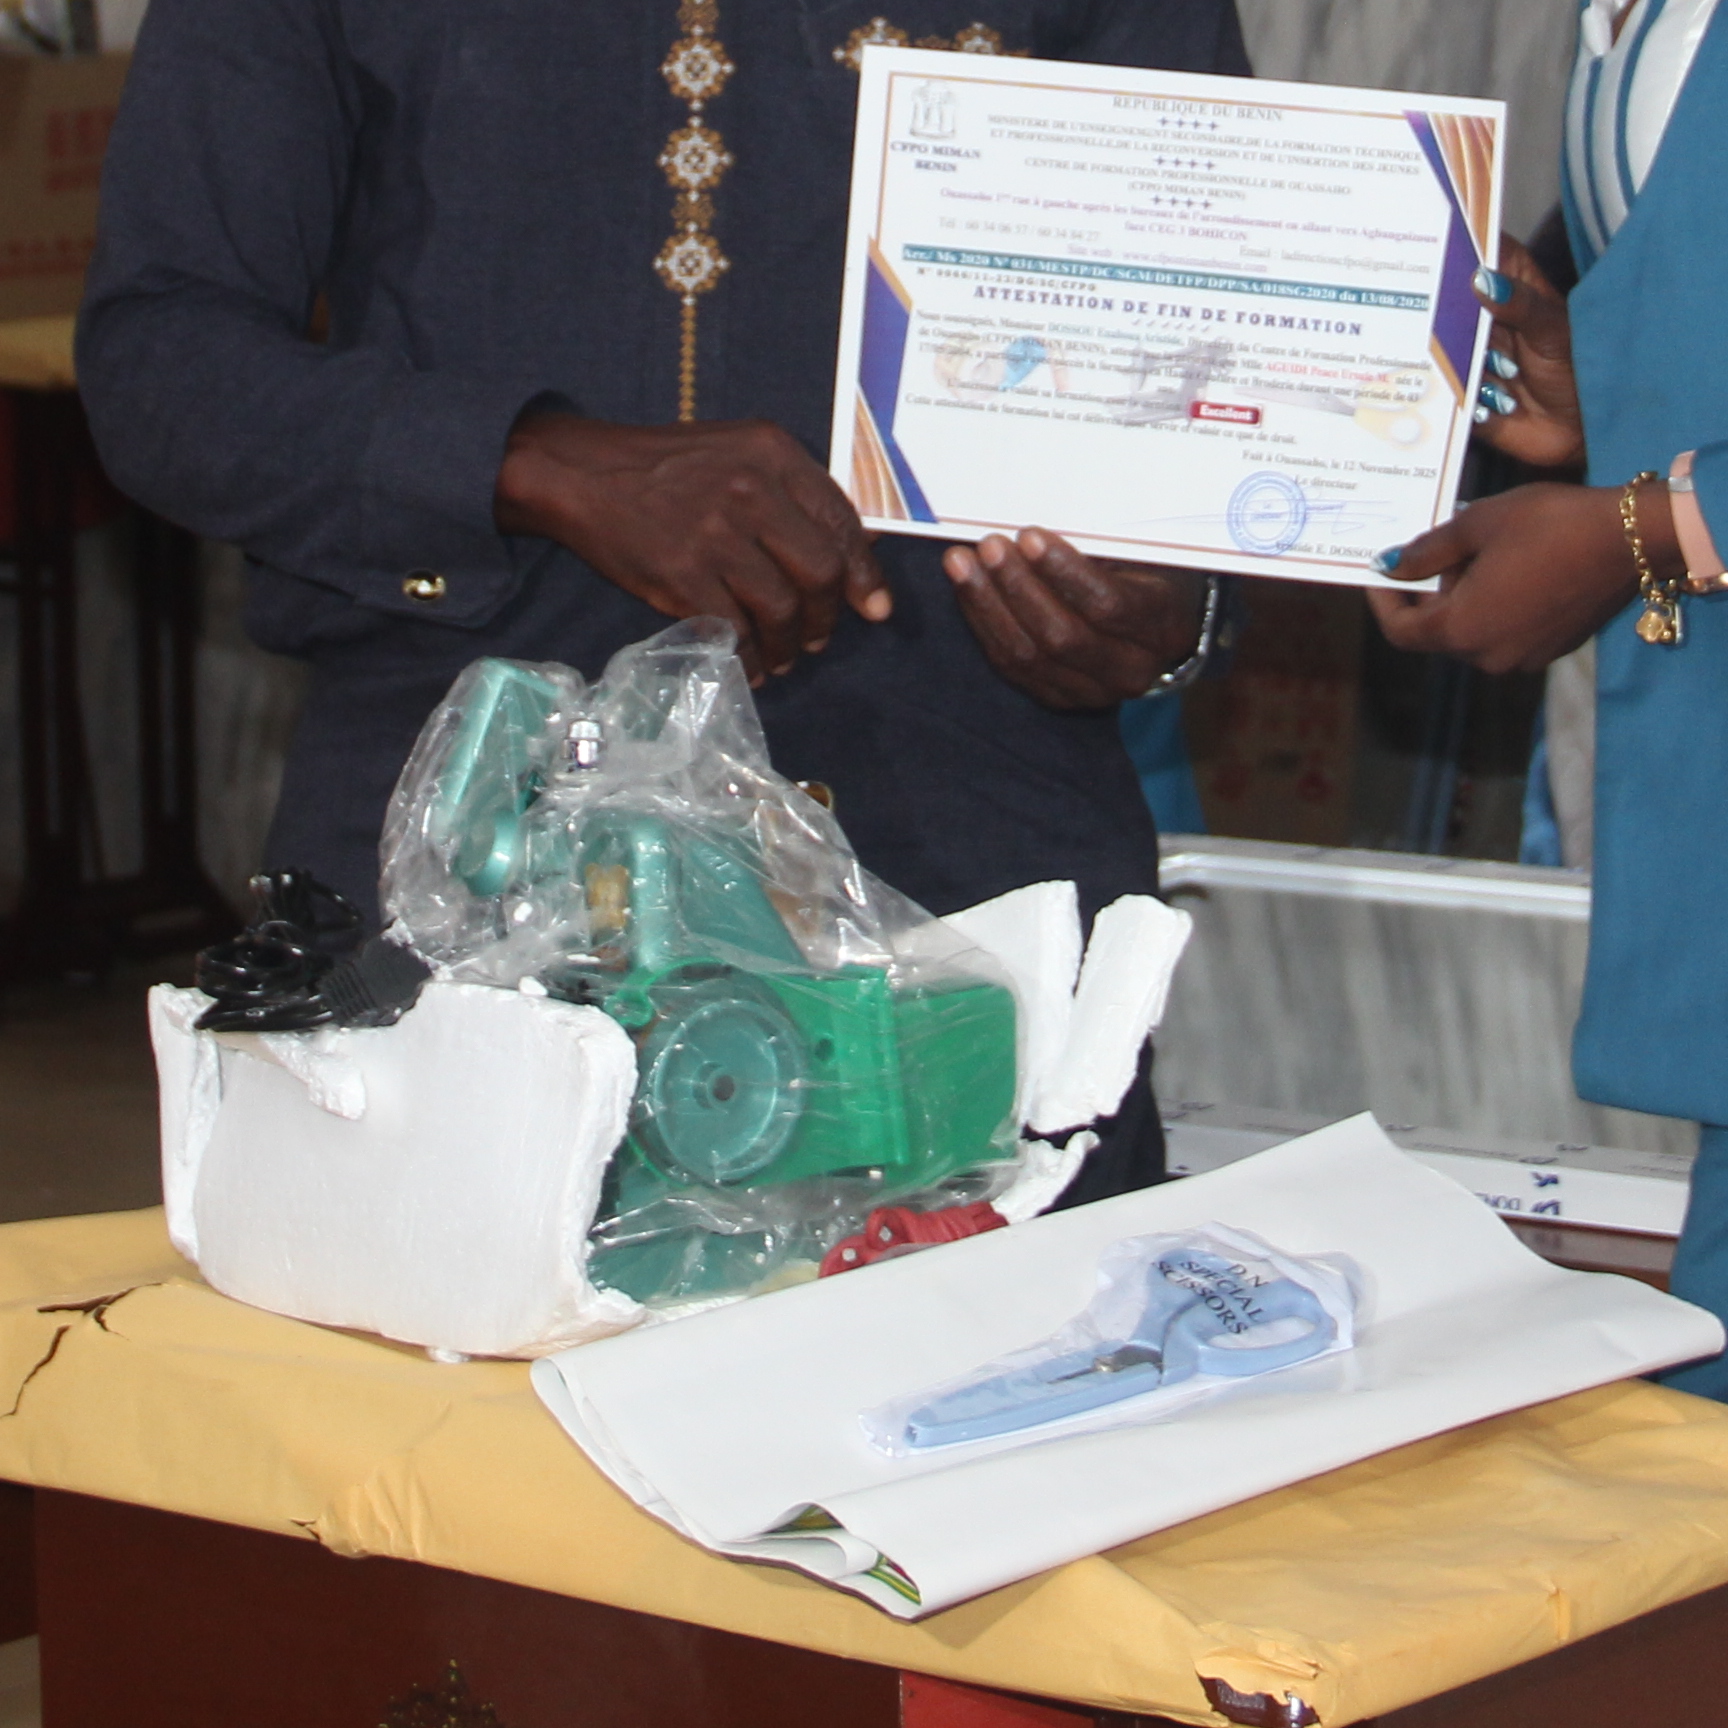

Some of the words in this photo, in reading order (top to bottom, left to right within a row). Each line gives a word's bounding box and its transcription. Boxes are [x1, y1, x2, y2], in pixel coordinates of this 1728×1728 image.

[1112, 95, 1207, 115] REPUBLIQUE
[1212, 104, 1231, 116] DU
[1236, 106, 1282, 121] BENIN
[890, 140, 928, 154] CFPO
[932, 145, 980, 158] MIMAN
[1052, 119, 1067, 129] DE
[1264, 139, 1279, 148] LA
[1281, 140, 1350, 154] FORMATION
[1355, 147, 1420, 161] TECHNIQUE
[990, 128, 1002, 137] ET
[1134, 141, 1147, 150] LA
[1151, 142, 1238, 159] RECONVERSION
[1243, 151, 1254, 160] ET
[1260, 152, 1271, 162] DE
[1352, 161, 1372, 171] DES
[1376, 163, 1418, 175] JEUNES
[914, 159, 956, 171] BENIN
[1024, 157, 1069, 169] CENTRE
[1072, 161, 1086, 171] DE
[1090, 163, 1157, 177] FORMATION
[1161, 169, 1266, 187] PROFESSIONNELLE
[1270, 179, 1284, 188] DE
[1288, 181, 1350, 194] OUASSAHO
[1164, 183, 1204, 196] MIMAN
[1176, 210, 1187, 219] de
[1188, 226, 1246, 240] BOHICON
[1339, 289, 1356, 301] du
[973, 284, 1112, 310] ATTESTATION
[1122, 299, 1147, 314] DE
[1156, 302, 1191, 318] FIN
[1200, 307, 1226, 322] DE
[1236, 310, 1362, 335] FORMATION
[1252, 343, 1286, 355] Centre
[1289, 346, 1300, 357] de
[1304, 348, 1354, 362] Formation
[1200, 403, 1252, 420] Excellent
[1343, 459, 1354, 470] 12
[1359, 460, 1409, 476] Novembre
[1155, 1260, 1249, 1334] SCISSORS
[1179, 1260, 1264, 1322] SPECIAL
